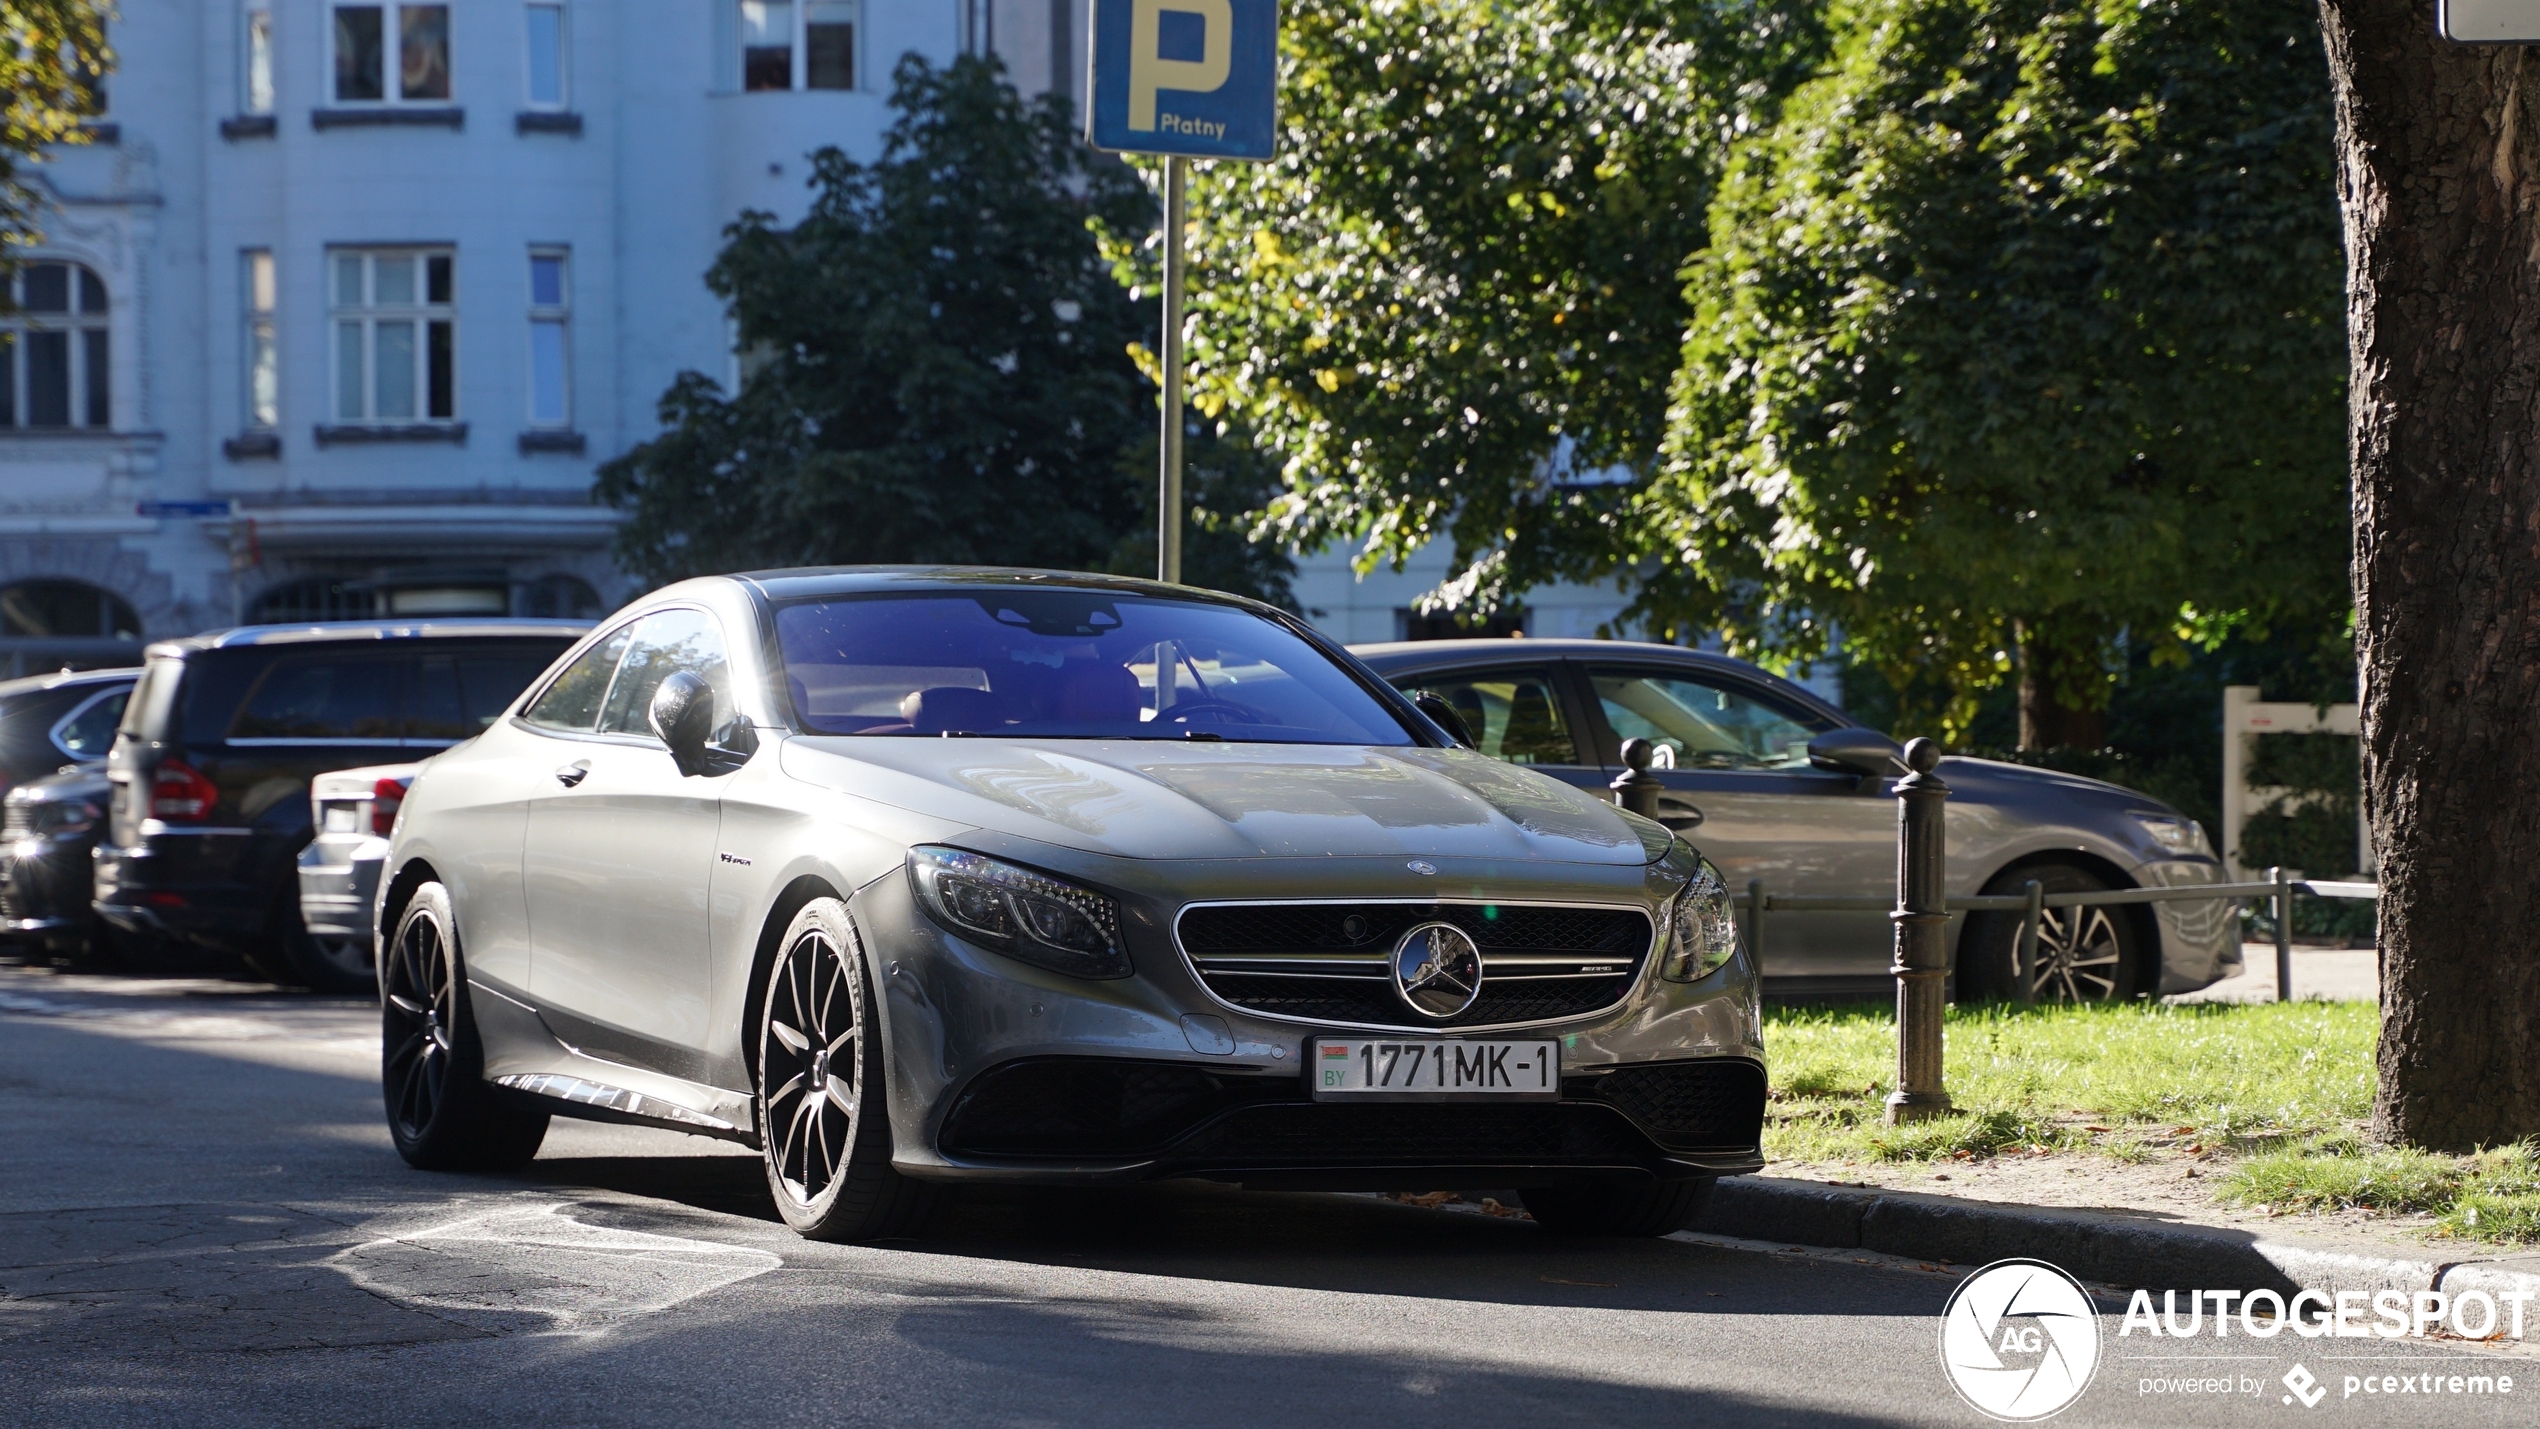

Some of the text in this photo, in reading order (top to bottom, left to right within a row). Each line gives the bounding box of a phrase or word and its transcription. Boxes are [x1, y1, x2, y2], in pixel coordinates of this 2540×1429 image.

[1128, 0, 1232, 132] P
[1161, 113, 1226, 141] Płatny
[1324, 1070, 1346, 1086] BY
[1361, 1045, 1547, 1087] 1771MK-1
